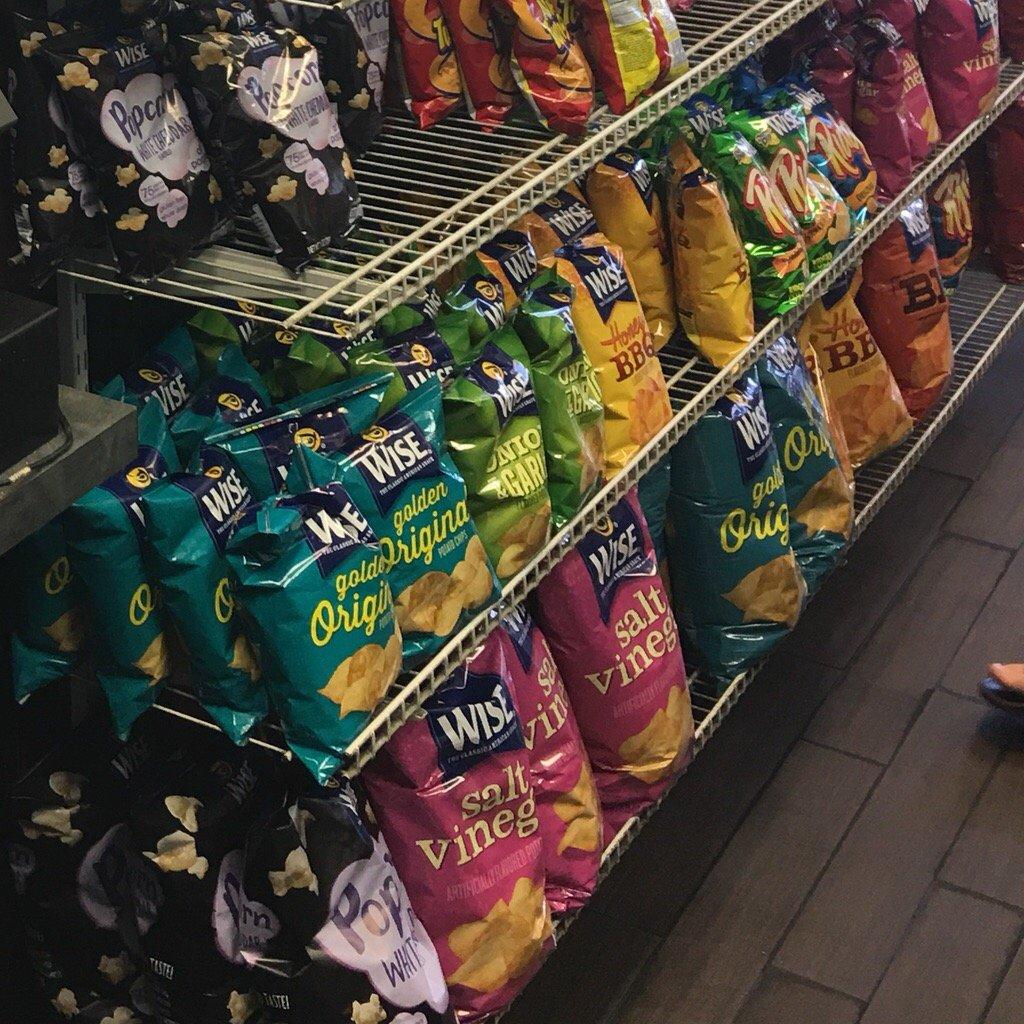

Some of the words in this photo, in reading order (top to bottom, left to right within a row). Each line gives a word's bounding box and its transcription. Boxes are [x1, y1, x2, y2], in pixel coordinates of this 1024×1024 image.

[114, 42, 150, 69] WISE
[549, 199, 594, 237] WISE
[584, 262, 628, 300] WISE
[357, 430, 428, 485] WISE
[201, 467, 250, 523] WISE
[393, 481, 449, 536] golden
[588, 523, 638, 586] WISE
[614, 584, 667, 649] salt
[436, 683, 516, 752] WISE
[461, 759, 530, 821] salt
[148, 957, 175, 981] TASTE!
[262, 992, 291, 1011] TASTE!
